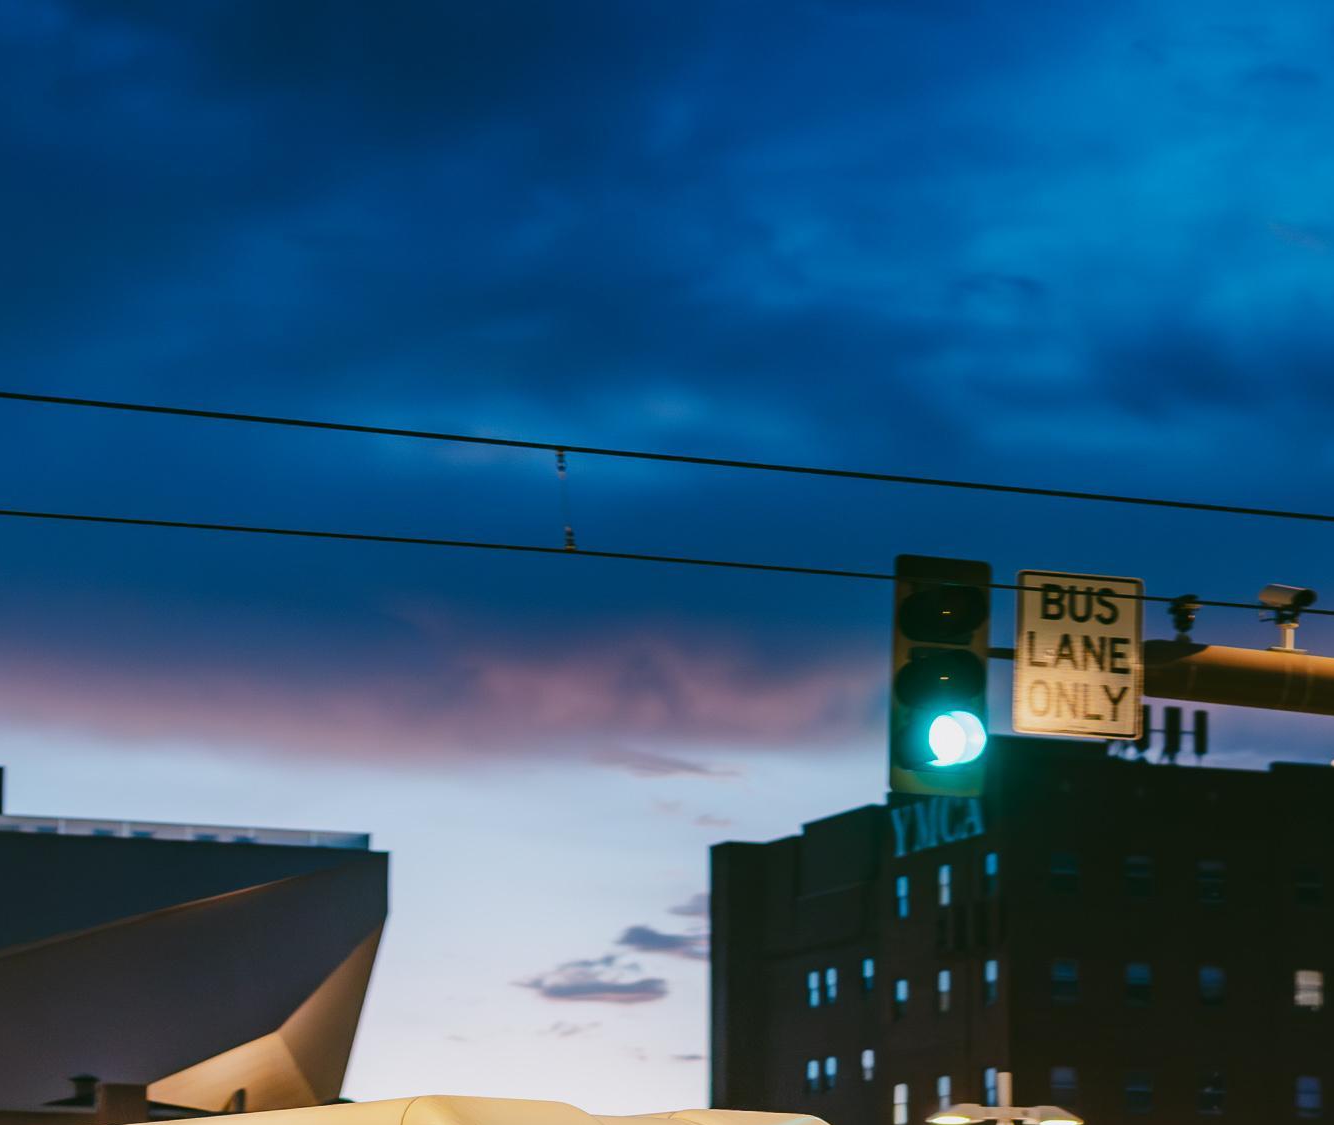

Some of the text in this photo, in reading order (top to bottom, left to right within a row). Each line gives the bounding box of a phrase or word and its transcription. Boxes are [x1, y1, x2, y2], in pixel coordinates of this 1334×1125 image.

[1041, 583, 1119, 625] BUS
[1028, 631, 1131, 675] LANE
[1028, 679, 1129, 722] ONLY
[891, 796, 985, 858] YMCA
